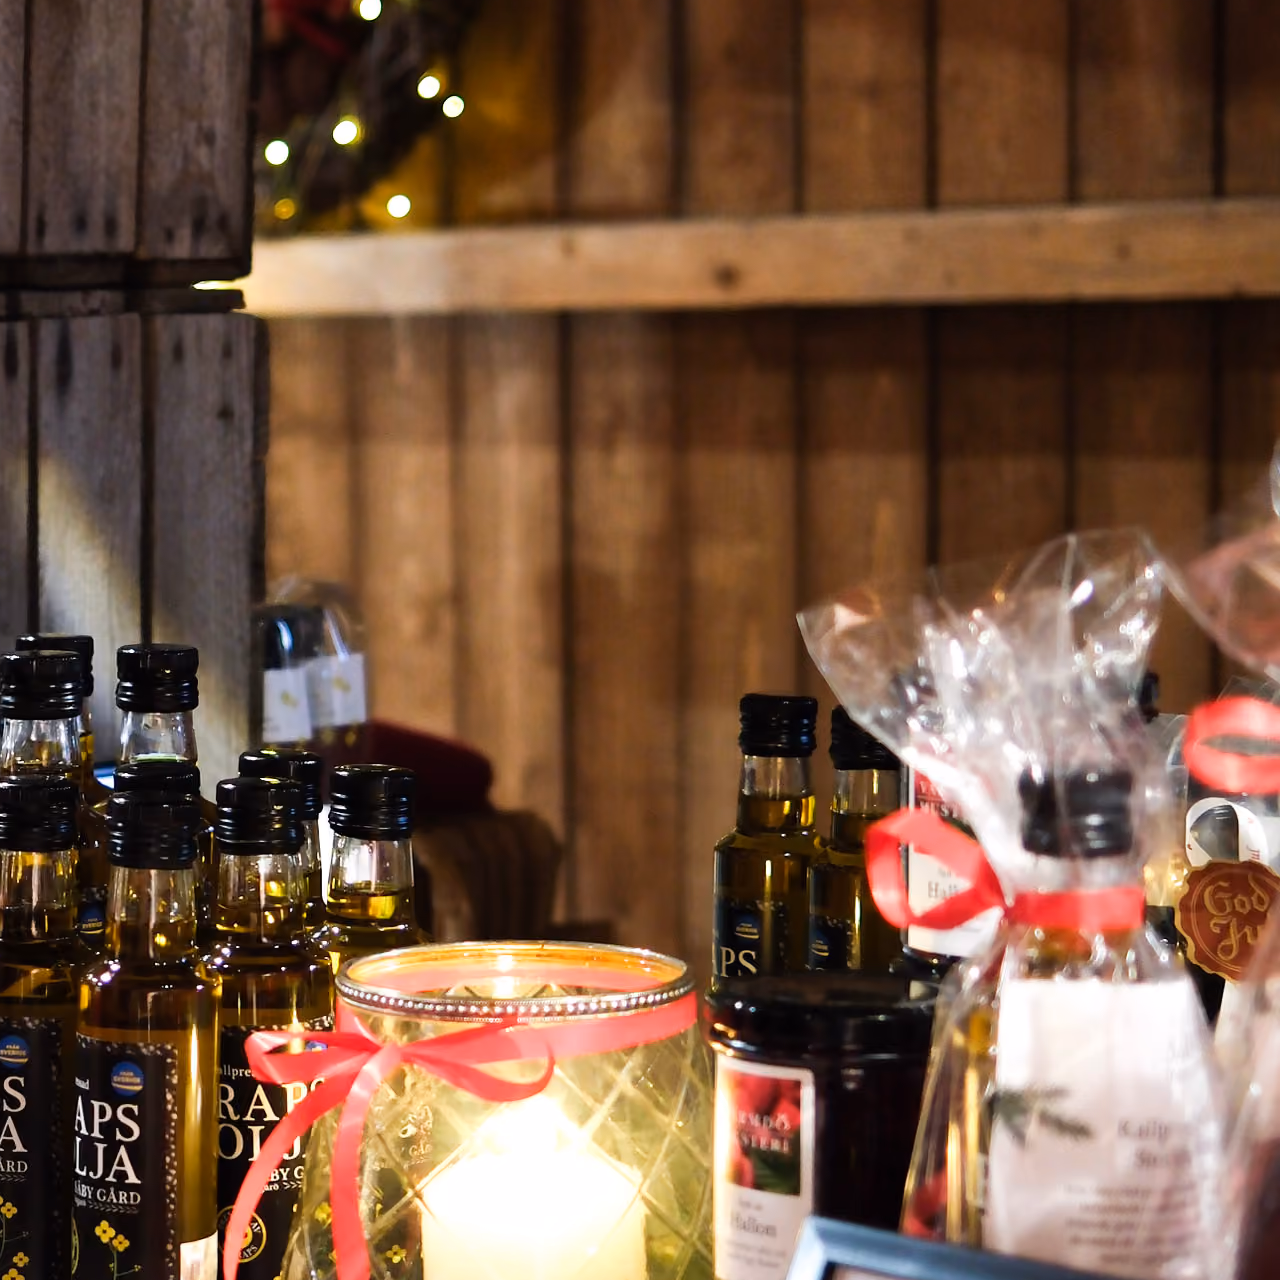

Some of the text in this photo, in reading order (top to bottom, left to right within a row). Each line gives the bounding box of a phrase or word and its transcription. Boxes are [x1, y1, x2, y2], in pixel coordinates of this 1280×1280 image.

[1203, 873, 1270, 916] God
[1209, 916, 1268, 961] Ju
[718, 946, 758, 978] PS
[216, 1122, 308, 1163] OLJ
[95, 1186, 142, 1206] GÅRD
